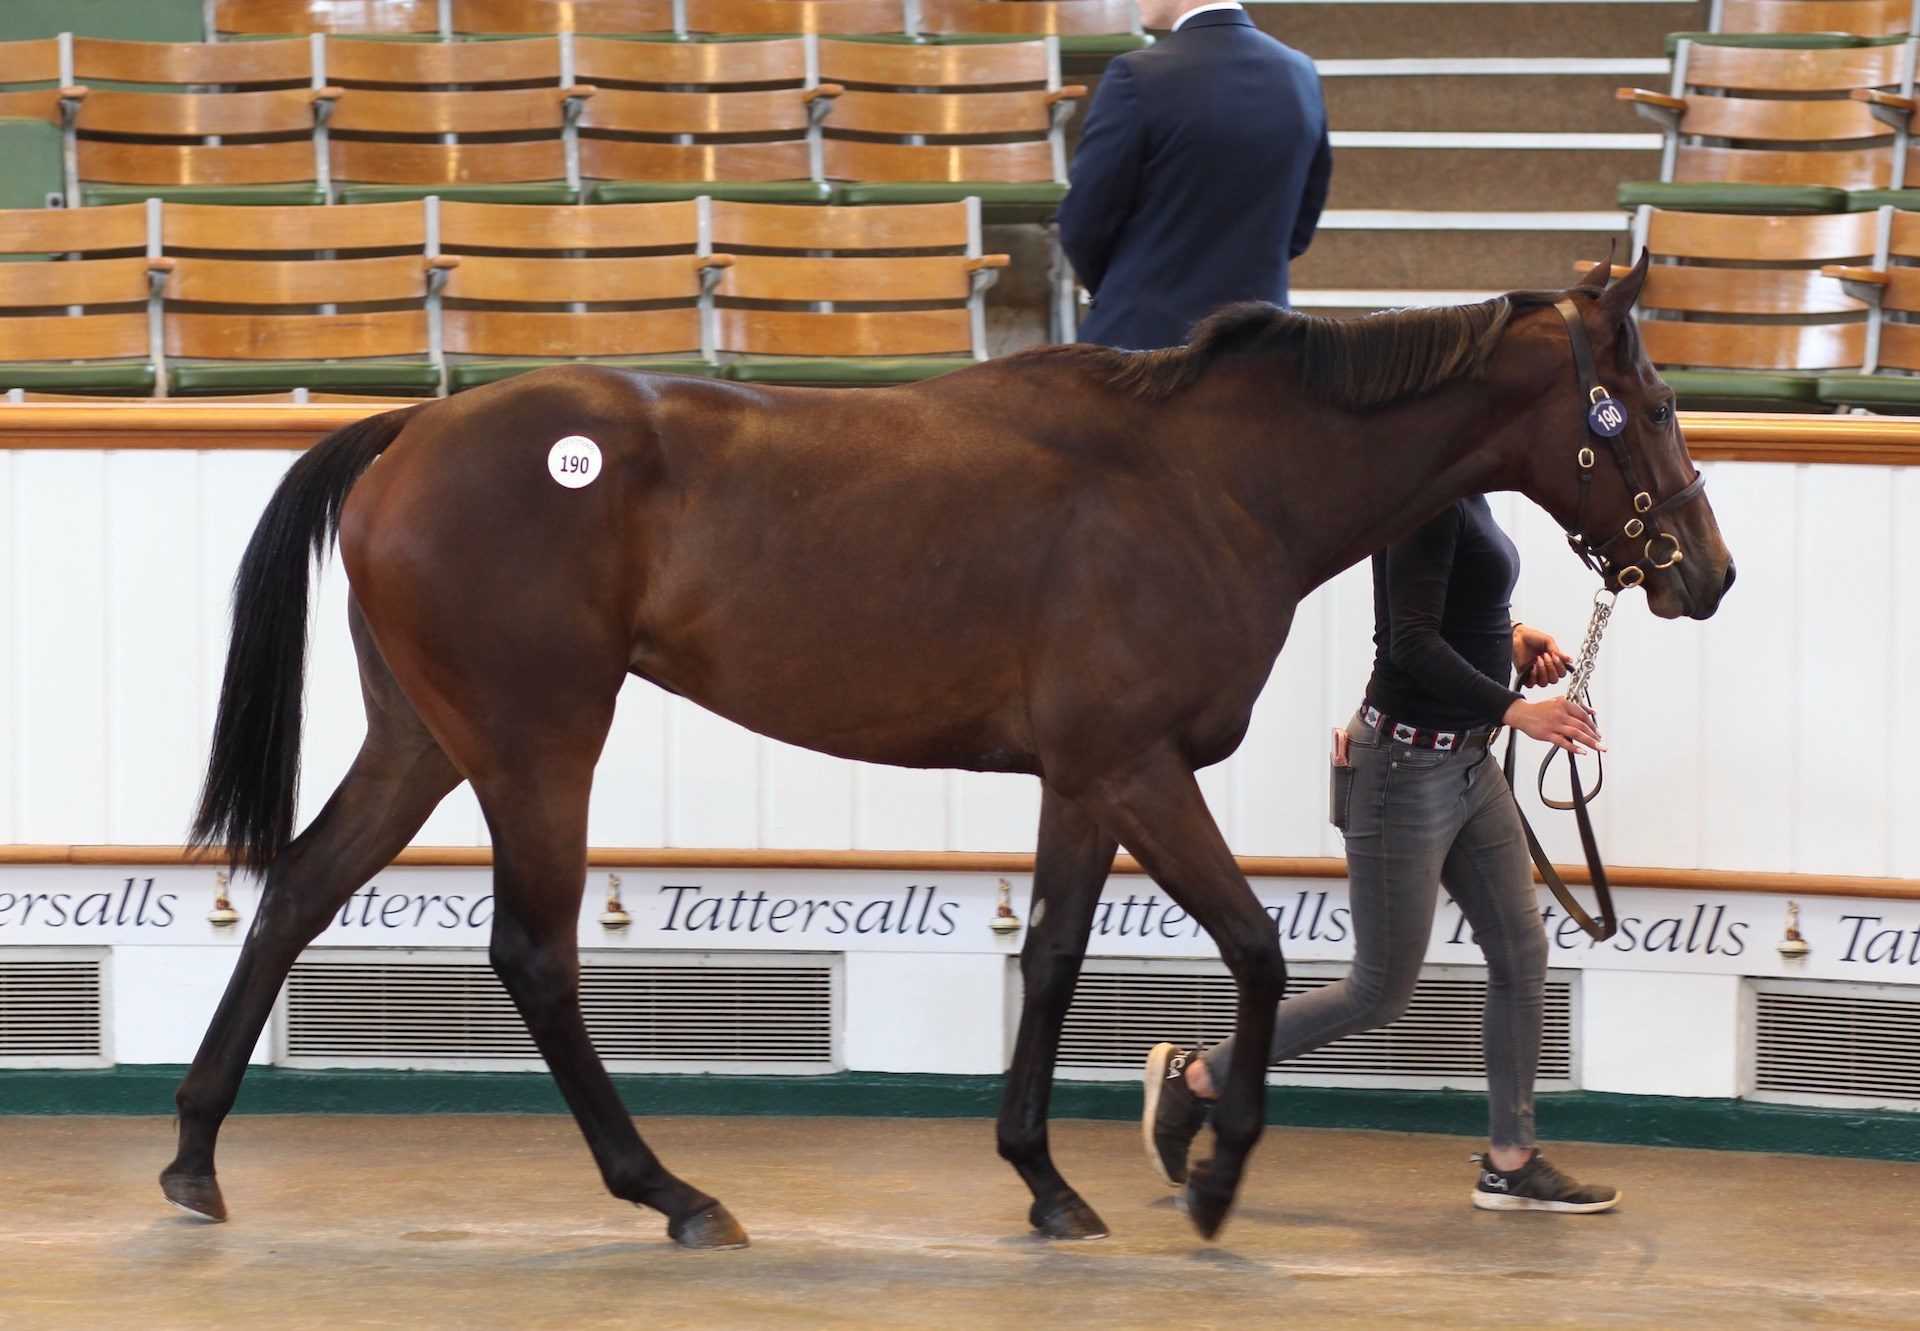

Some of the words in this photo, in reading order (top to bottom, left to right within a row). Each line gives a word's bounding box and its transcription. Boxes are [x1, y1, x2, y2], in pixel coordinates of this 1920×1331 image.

[1597, 405, 1623, 431] 190
[560, 455, 590, 475] 190
[657, 885, 961, 936] Tattersalls
